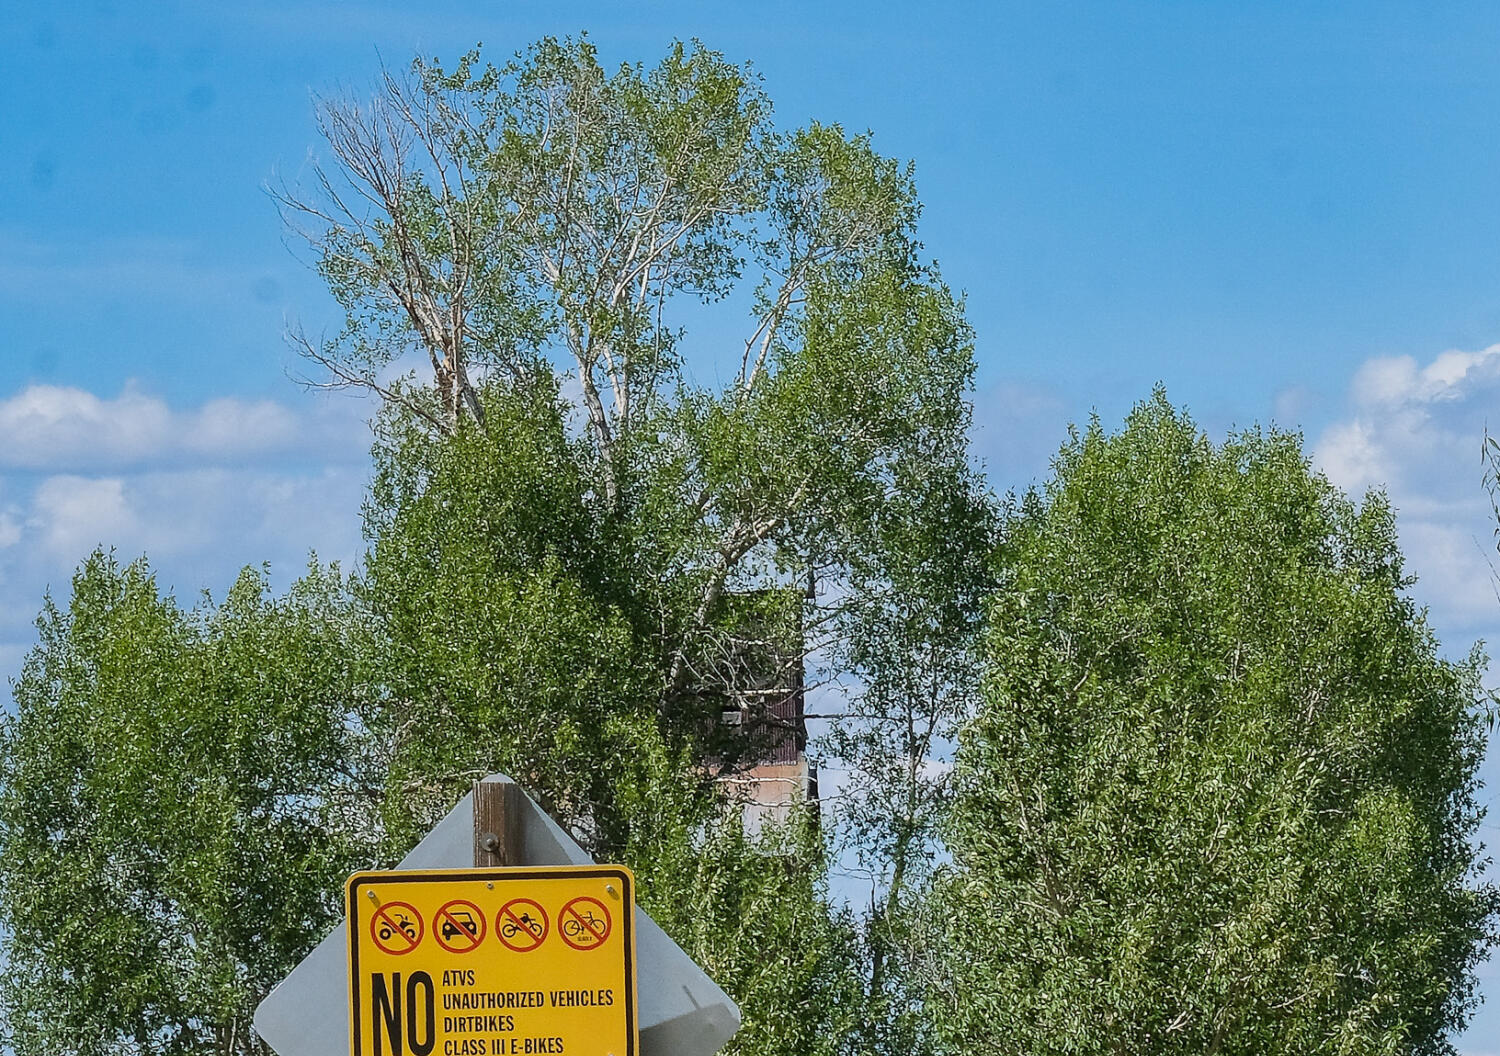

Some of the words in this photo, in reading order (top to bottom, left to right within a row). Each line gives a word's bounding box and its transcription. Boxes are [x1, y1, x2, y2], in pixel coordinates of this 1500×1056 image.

[442, 969, 476, 987] ATVS
[443, 991, 545, 1010] UNAUTHORIZED
[549, 989, 614, 1008] VEHICLES
[443, 1015, 515, 1033] DIRTBIKES
[444, 1039, 487, 1056] CLASS
[491, 1038, 506, 1056] III
[510, 1037, 564, 1055] E-BIKES
